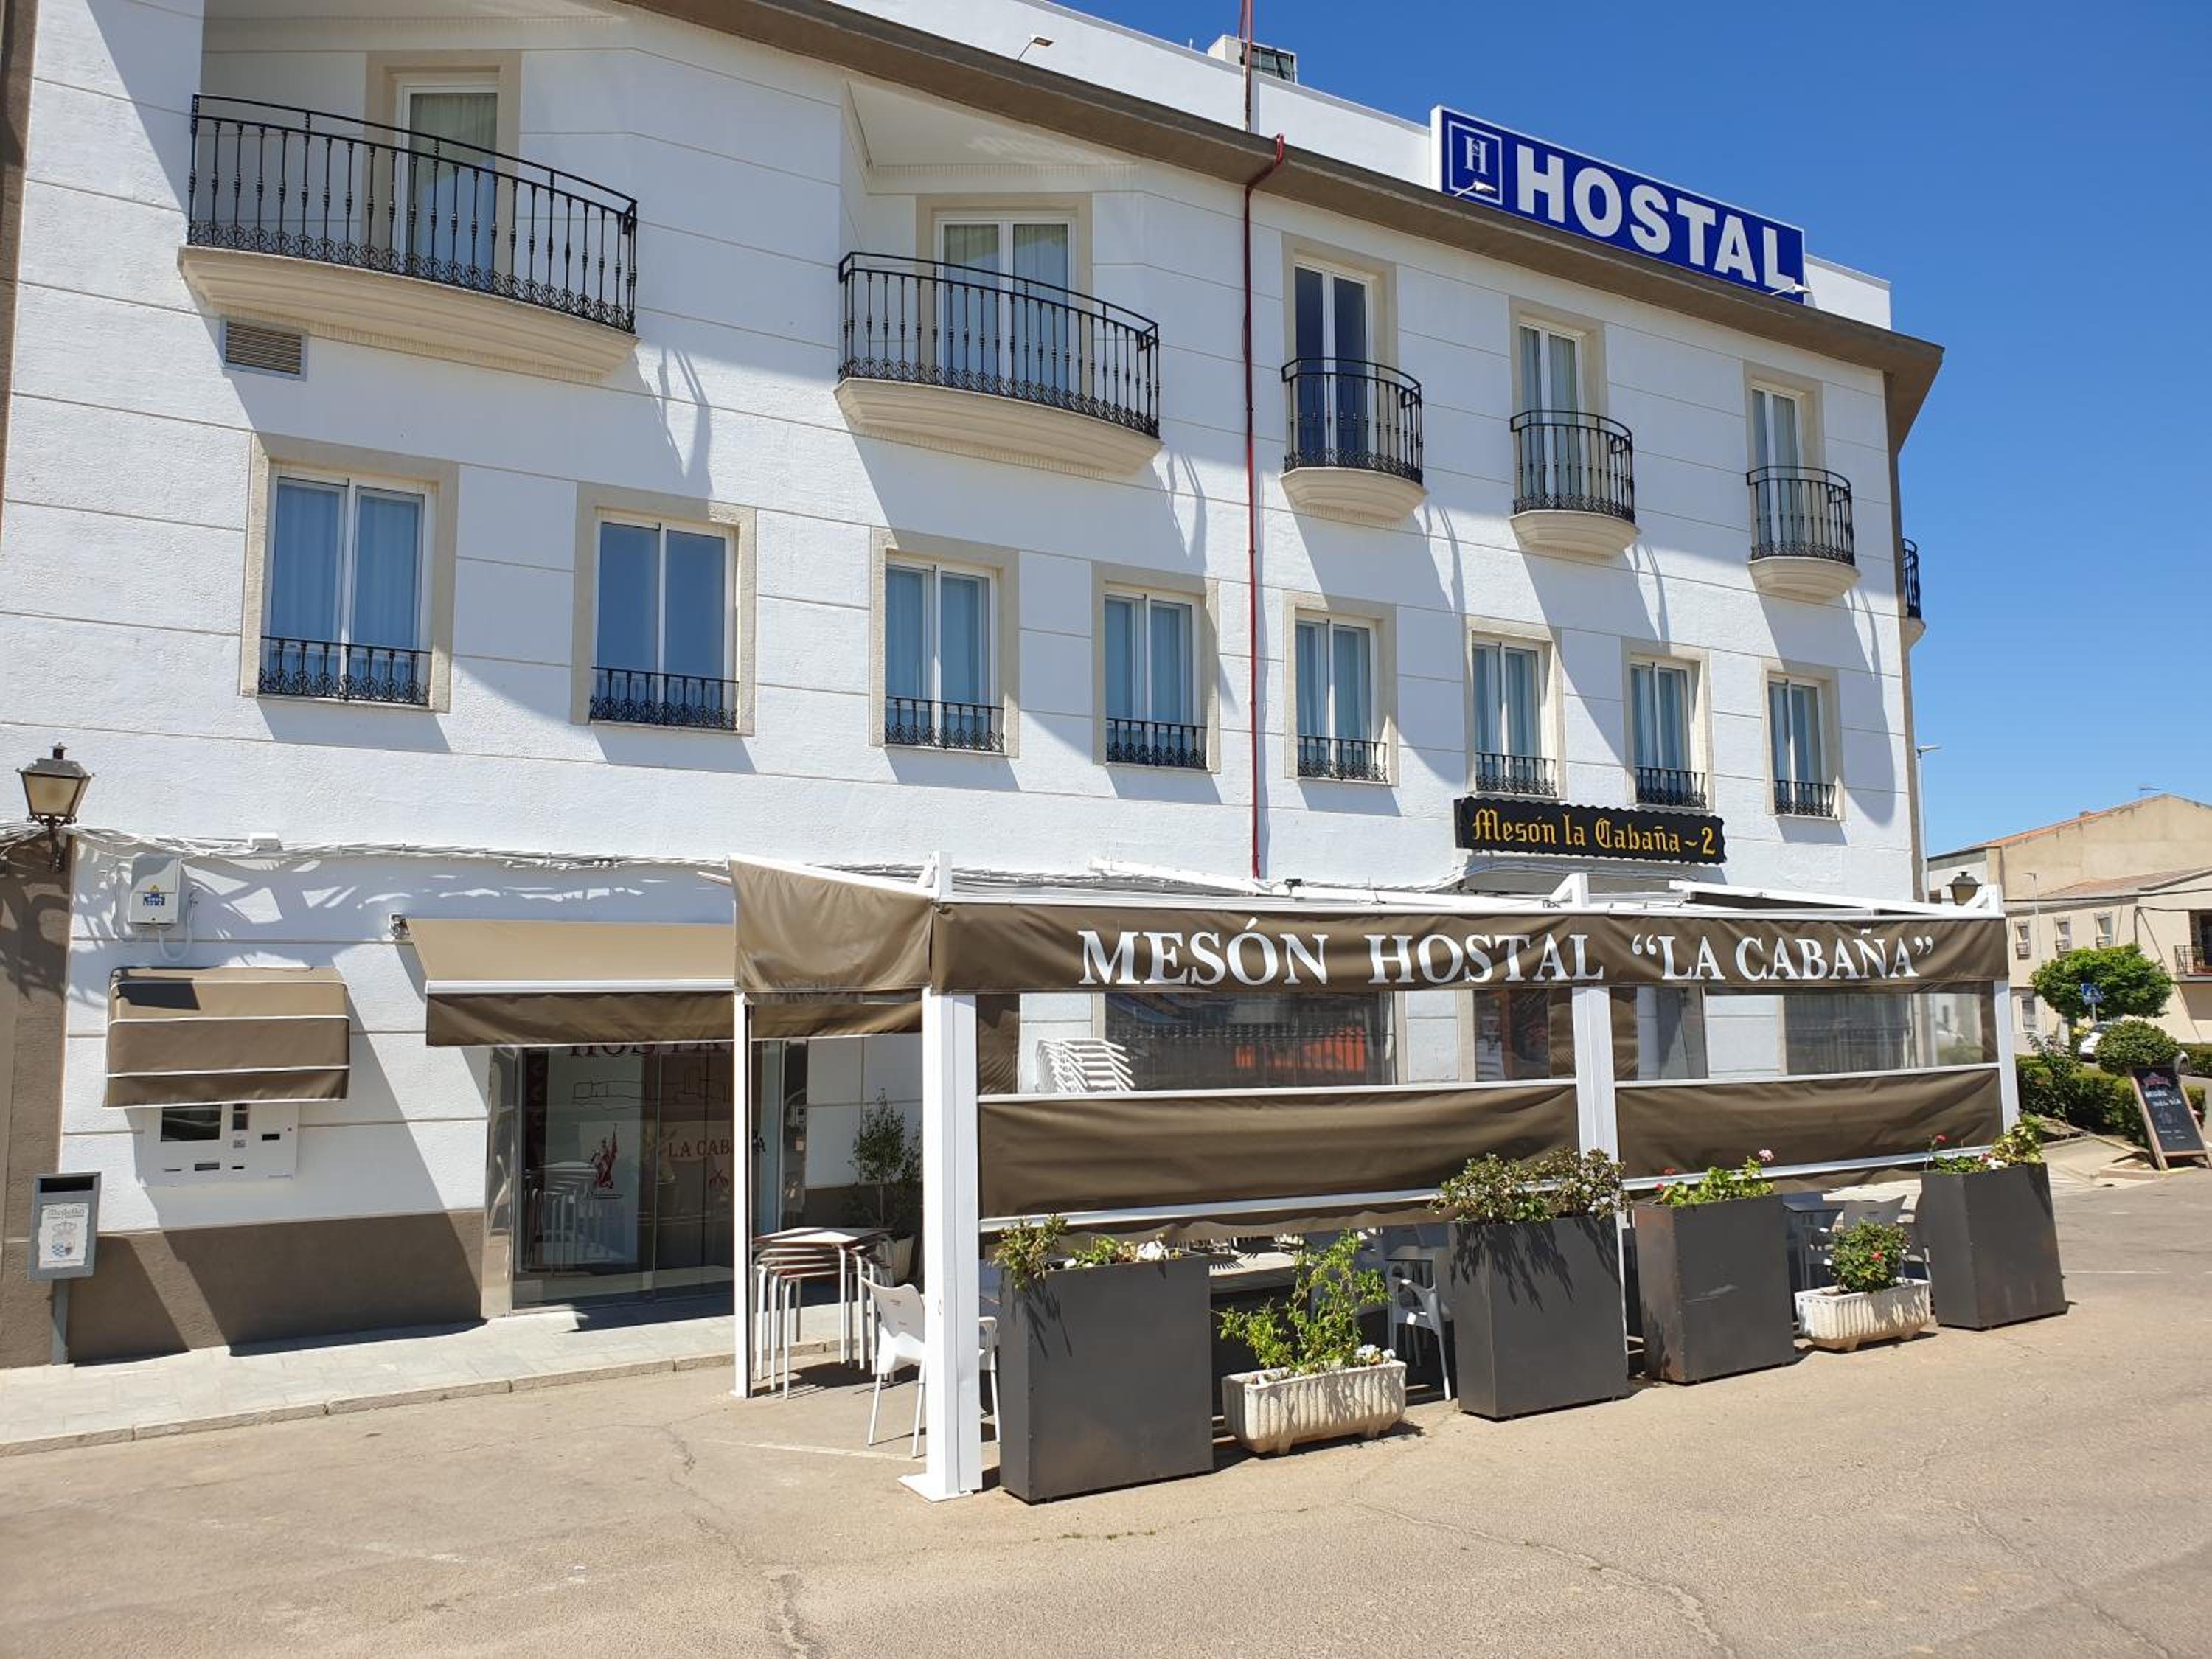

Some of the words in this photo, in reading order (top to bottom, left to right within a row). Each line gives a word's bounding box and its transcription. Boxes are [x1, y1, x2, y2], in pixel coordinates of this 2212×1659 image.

[1517, 144, 1795, 294] HOSTAL
[1473, 808, 1557, 844] Mesón
[1563, 813, 1586, 847] la
[1078, 917, 1329, 986] MESÓN
[1365, 933, 1605, 984] HOSTAL
